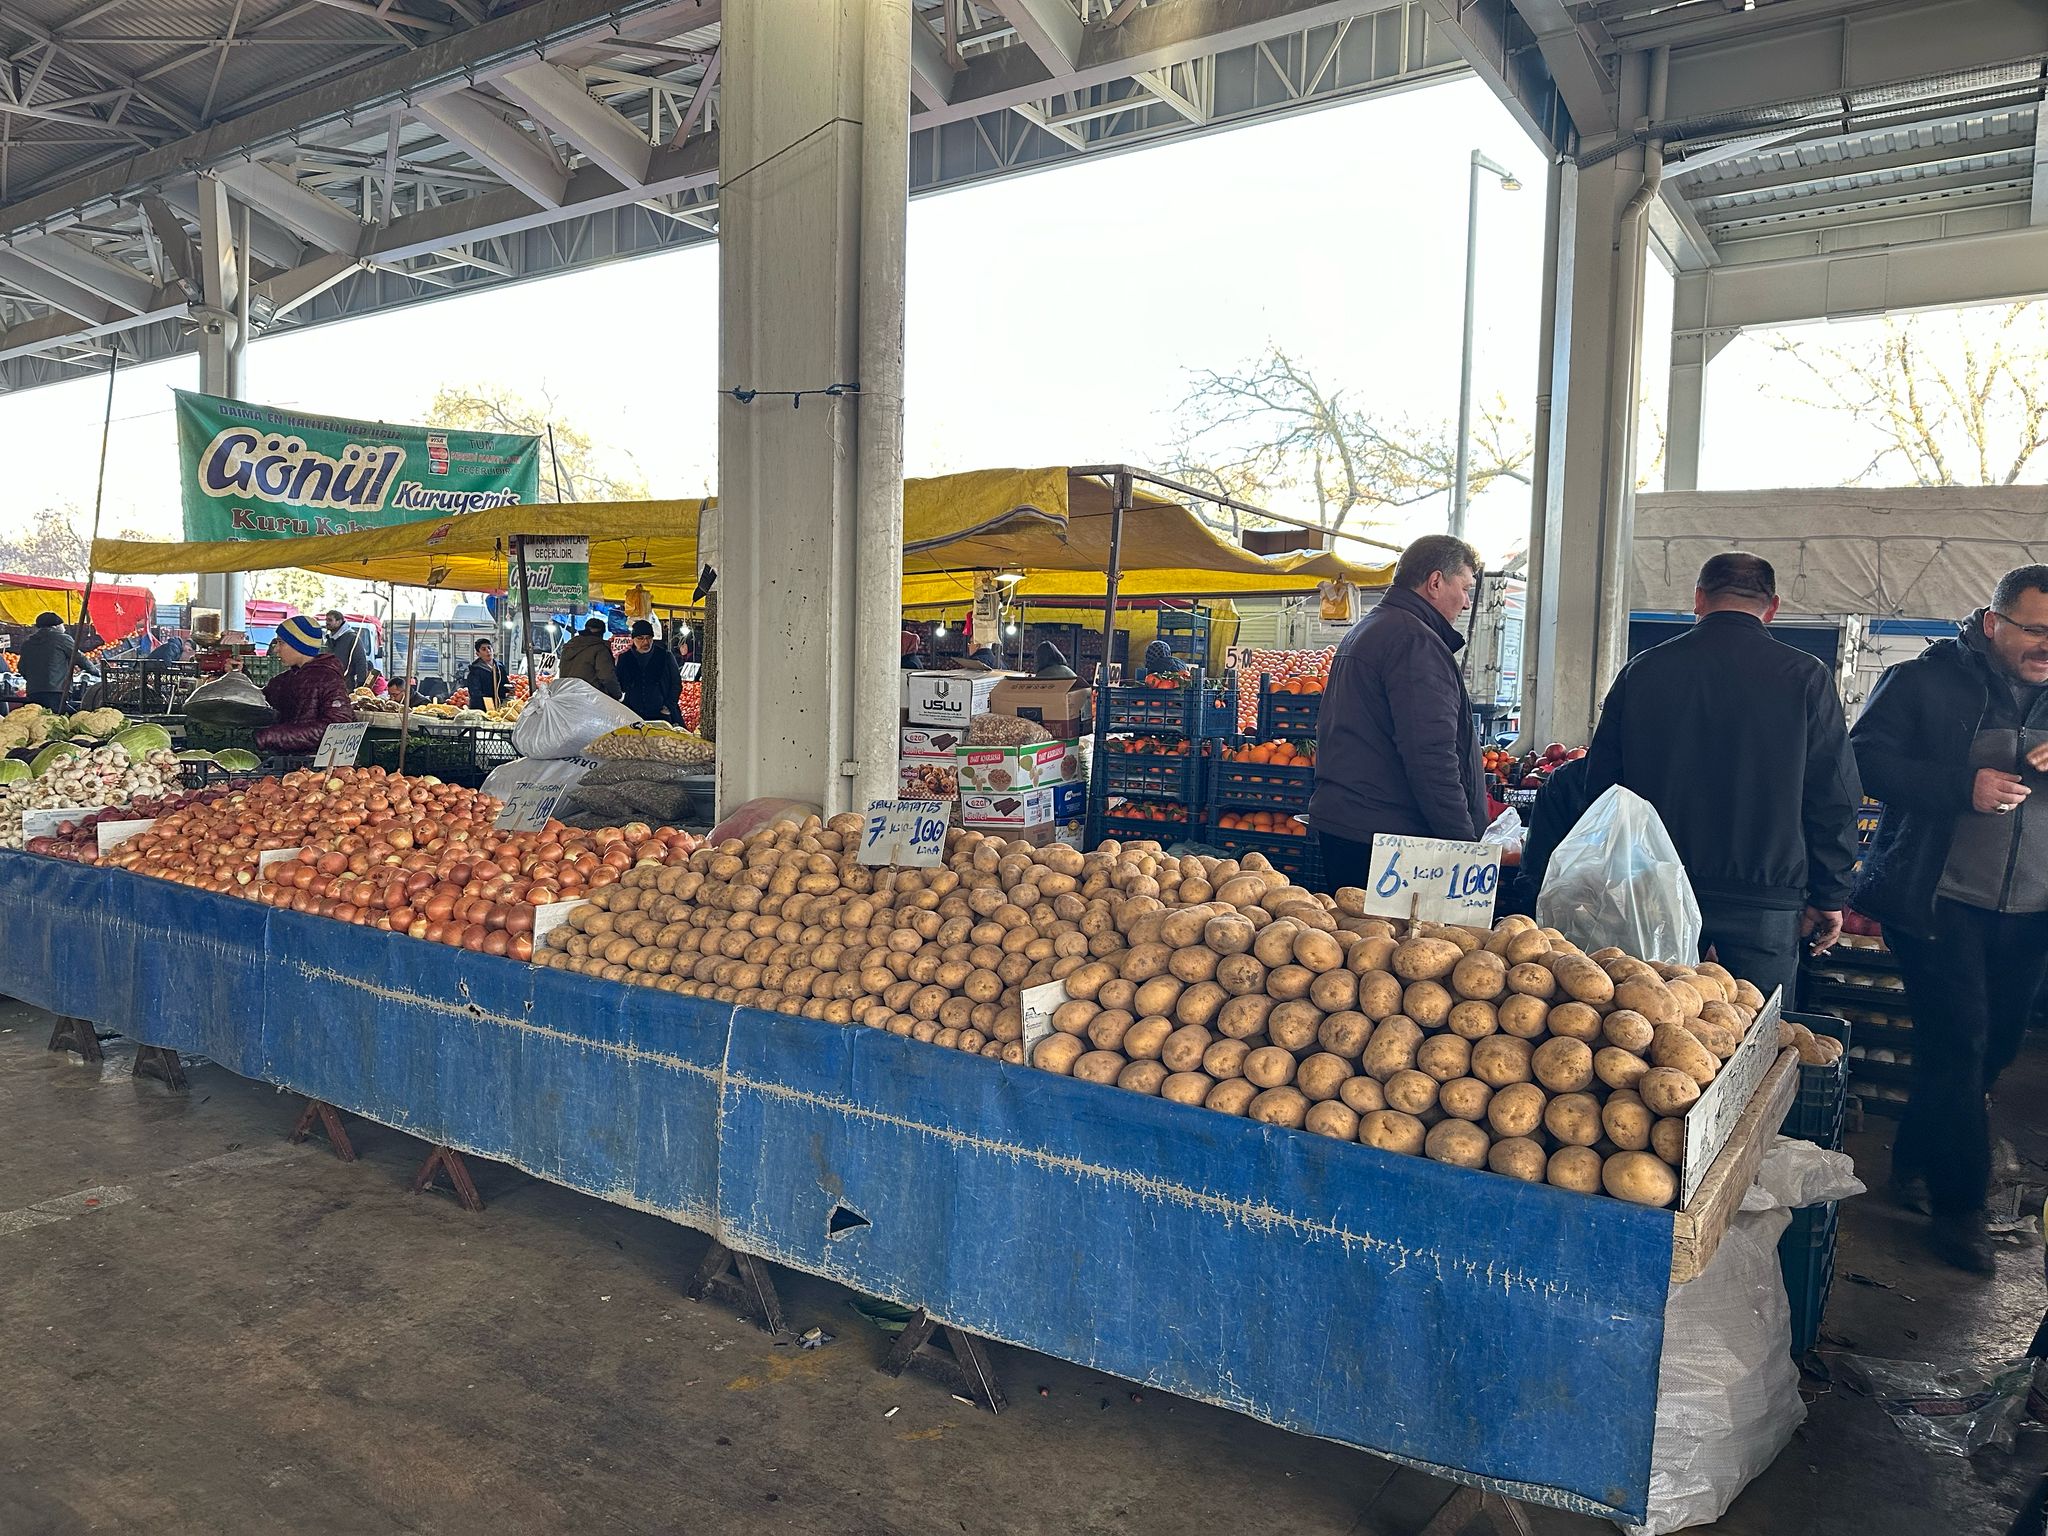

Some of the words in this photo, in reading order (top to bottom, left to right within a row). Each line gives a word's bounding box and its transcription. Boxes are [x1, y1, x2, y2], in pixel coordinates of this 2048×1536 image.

[267, 412, 283, 425] EN
[205, 432, 401, 507] Gönül
[231, 507, 309, 534] Kuru
[922, 699, 962, 712] USLU
[908, 816, 945, 846] 100
[1445, 863, 1499, 900] 100
